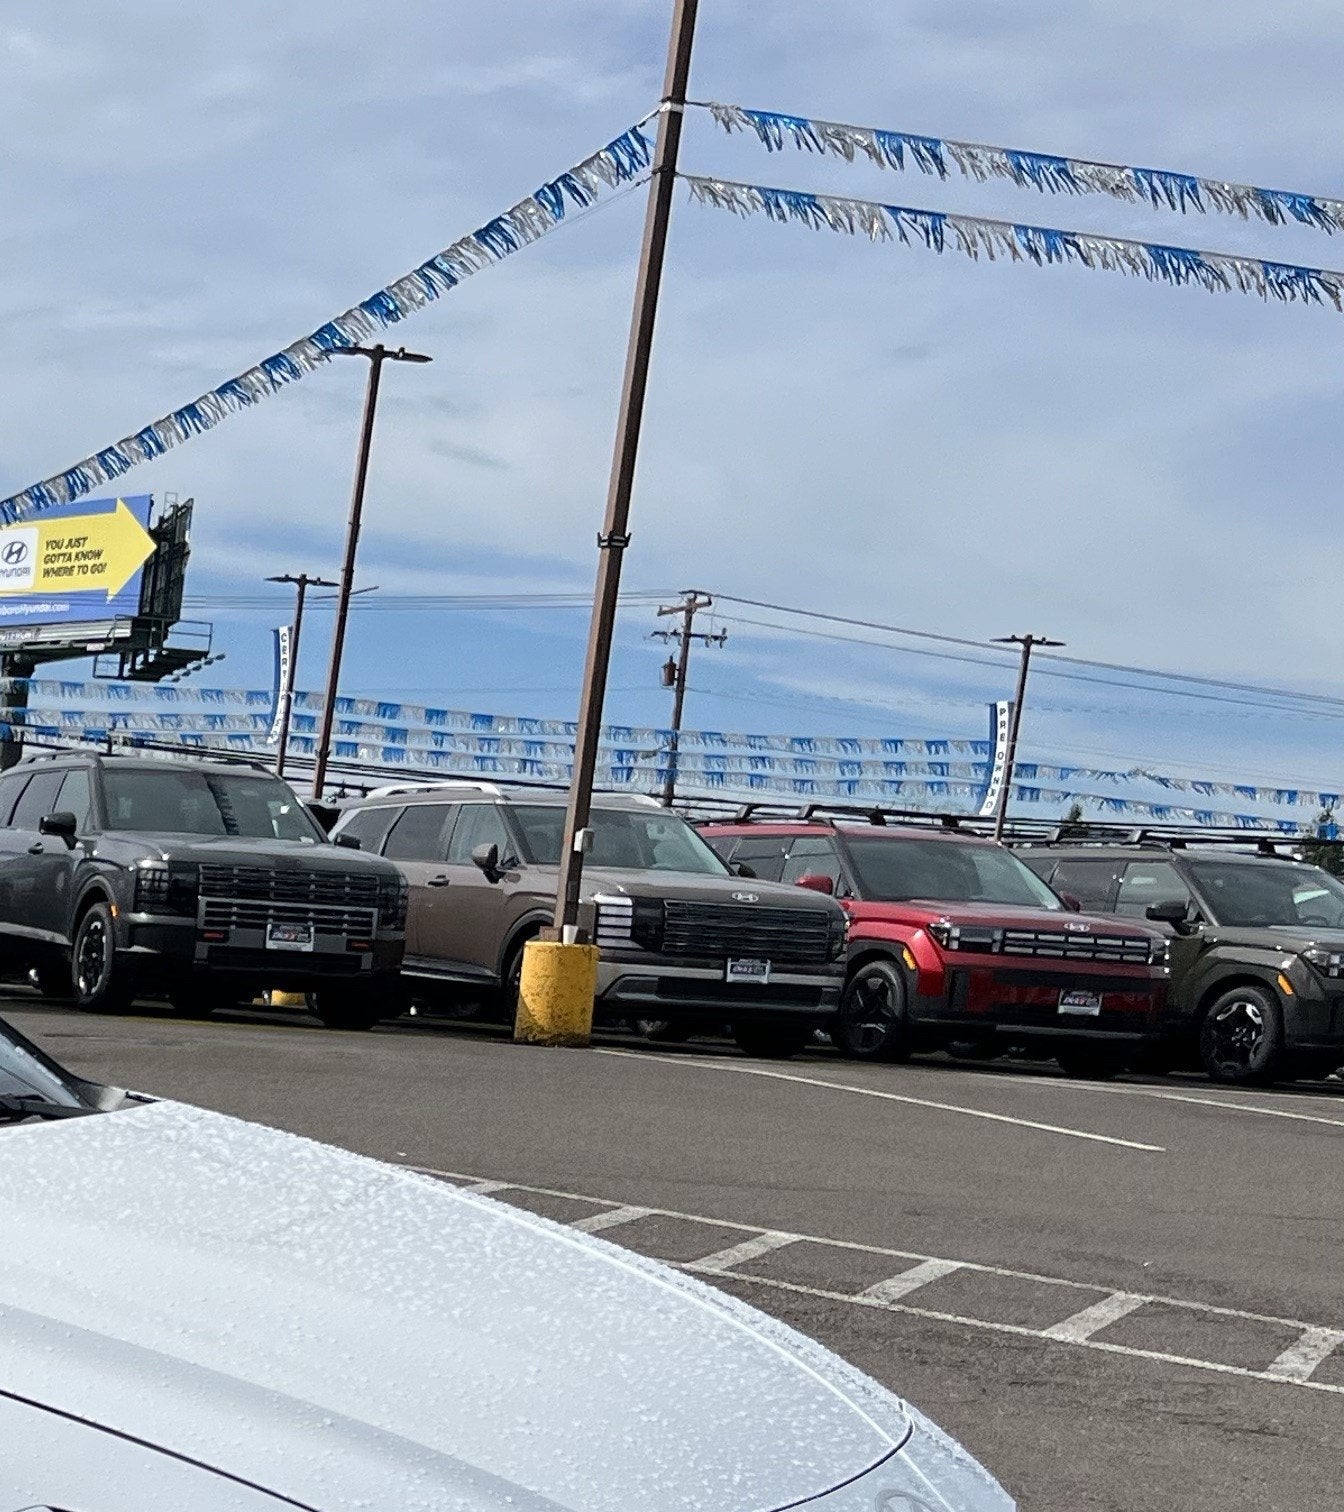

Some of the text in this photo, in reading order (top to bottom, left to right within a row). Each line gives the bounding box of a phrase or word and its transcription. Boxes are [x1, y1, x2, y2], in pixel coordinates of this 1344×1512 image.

[46, 536, 88, 551] YOU JUST
[44, 549, 104, 565] GOTTA KNOW
[43, 562, 107, 578] WHERE TO GO!
[999, 707, 1007, 742] PRE
